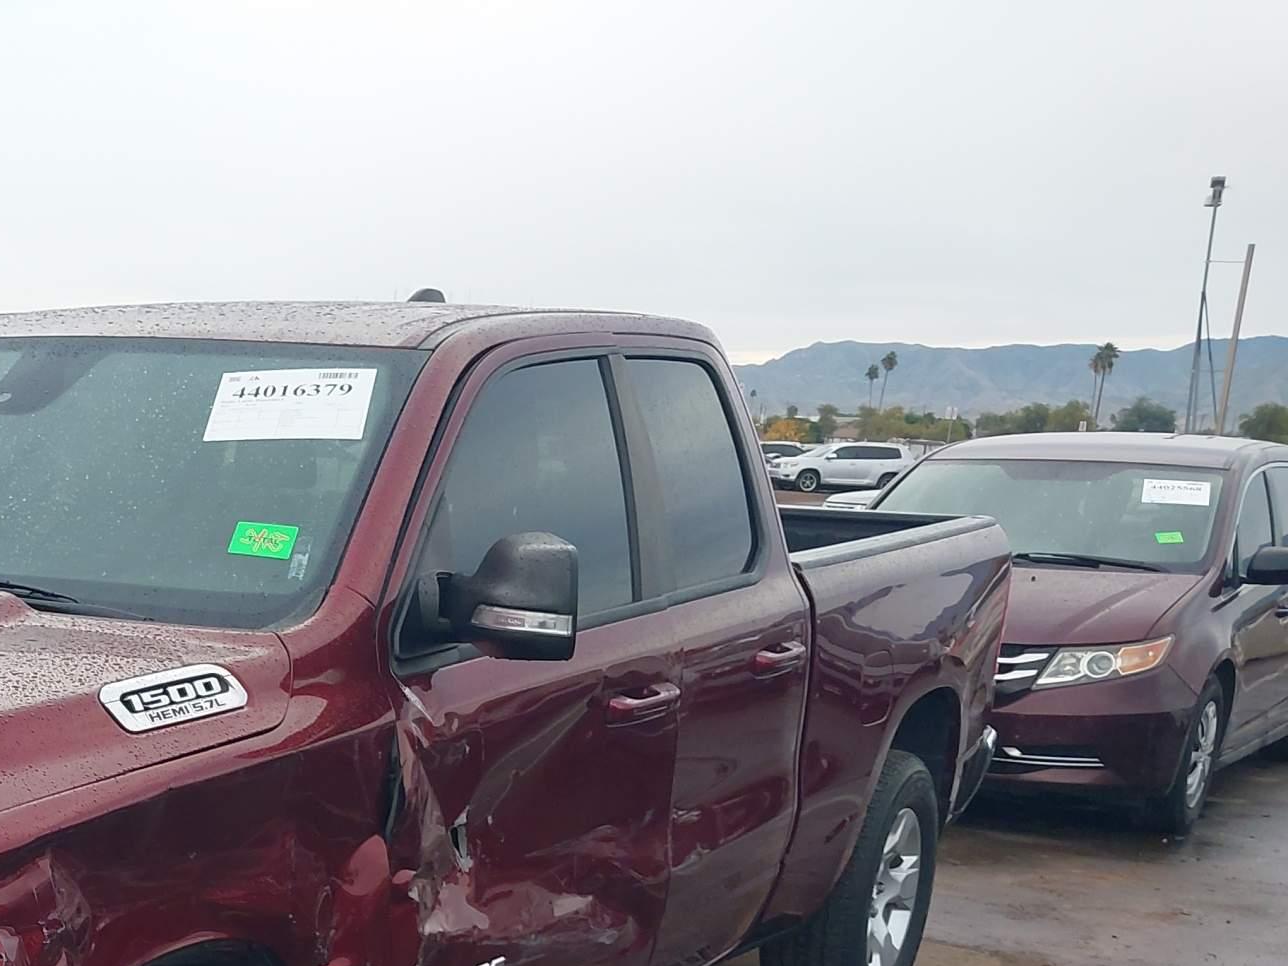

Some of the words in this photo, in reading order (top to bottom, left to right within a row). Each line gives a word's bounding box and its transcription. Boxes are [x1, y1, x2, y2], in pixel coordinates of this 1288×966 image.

[232, 383, 353, 399] 44016379
[125, 676, 222, 712] 1500
[149, 705, 190, 723] HEMI
[192, 698, 227, 712] 5.7L
